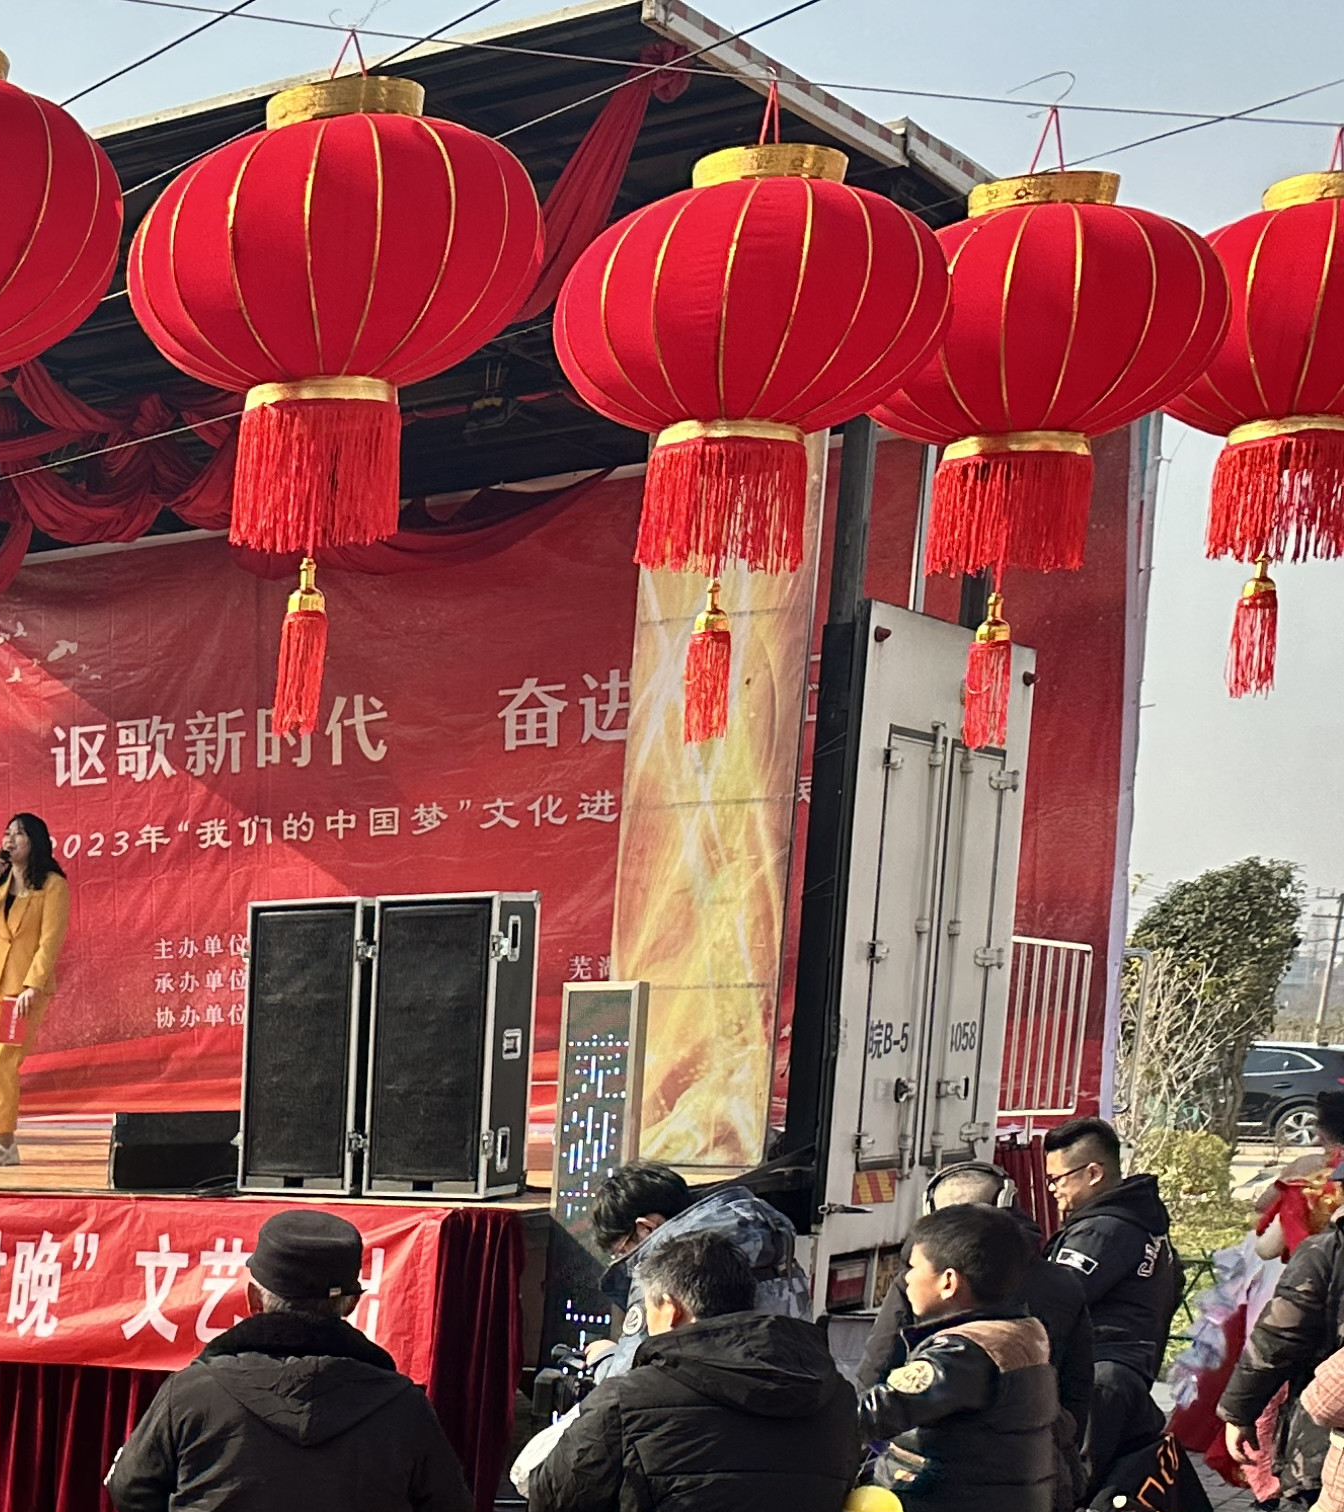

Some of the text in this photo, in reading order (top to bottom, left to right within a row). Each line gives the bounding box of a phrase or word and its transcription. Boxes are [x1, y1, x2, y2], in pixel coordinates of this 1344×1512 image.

[51, 693, 388, 788] 讴歌新时代
[50, 789, 620, 860] 023年“我们的中国梦”文化进
[153, 933, 249, 960] 主办单位
[154, 969, 248, 994] 承办单位
[154, 1003, 247, 1029] 协办单位
